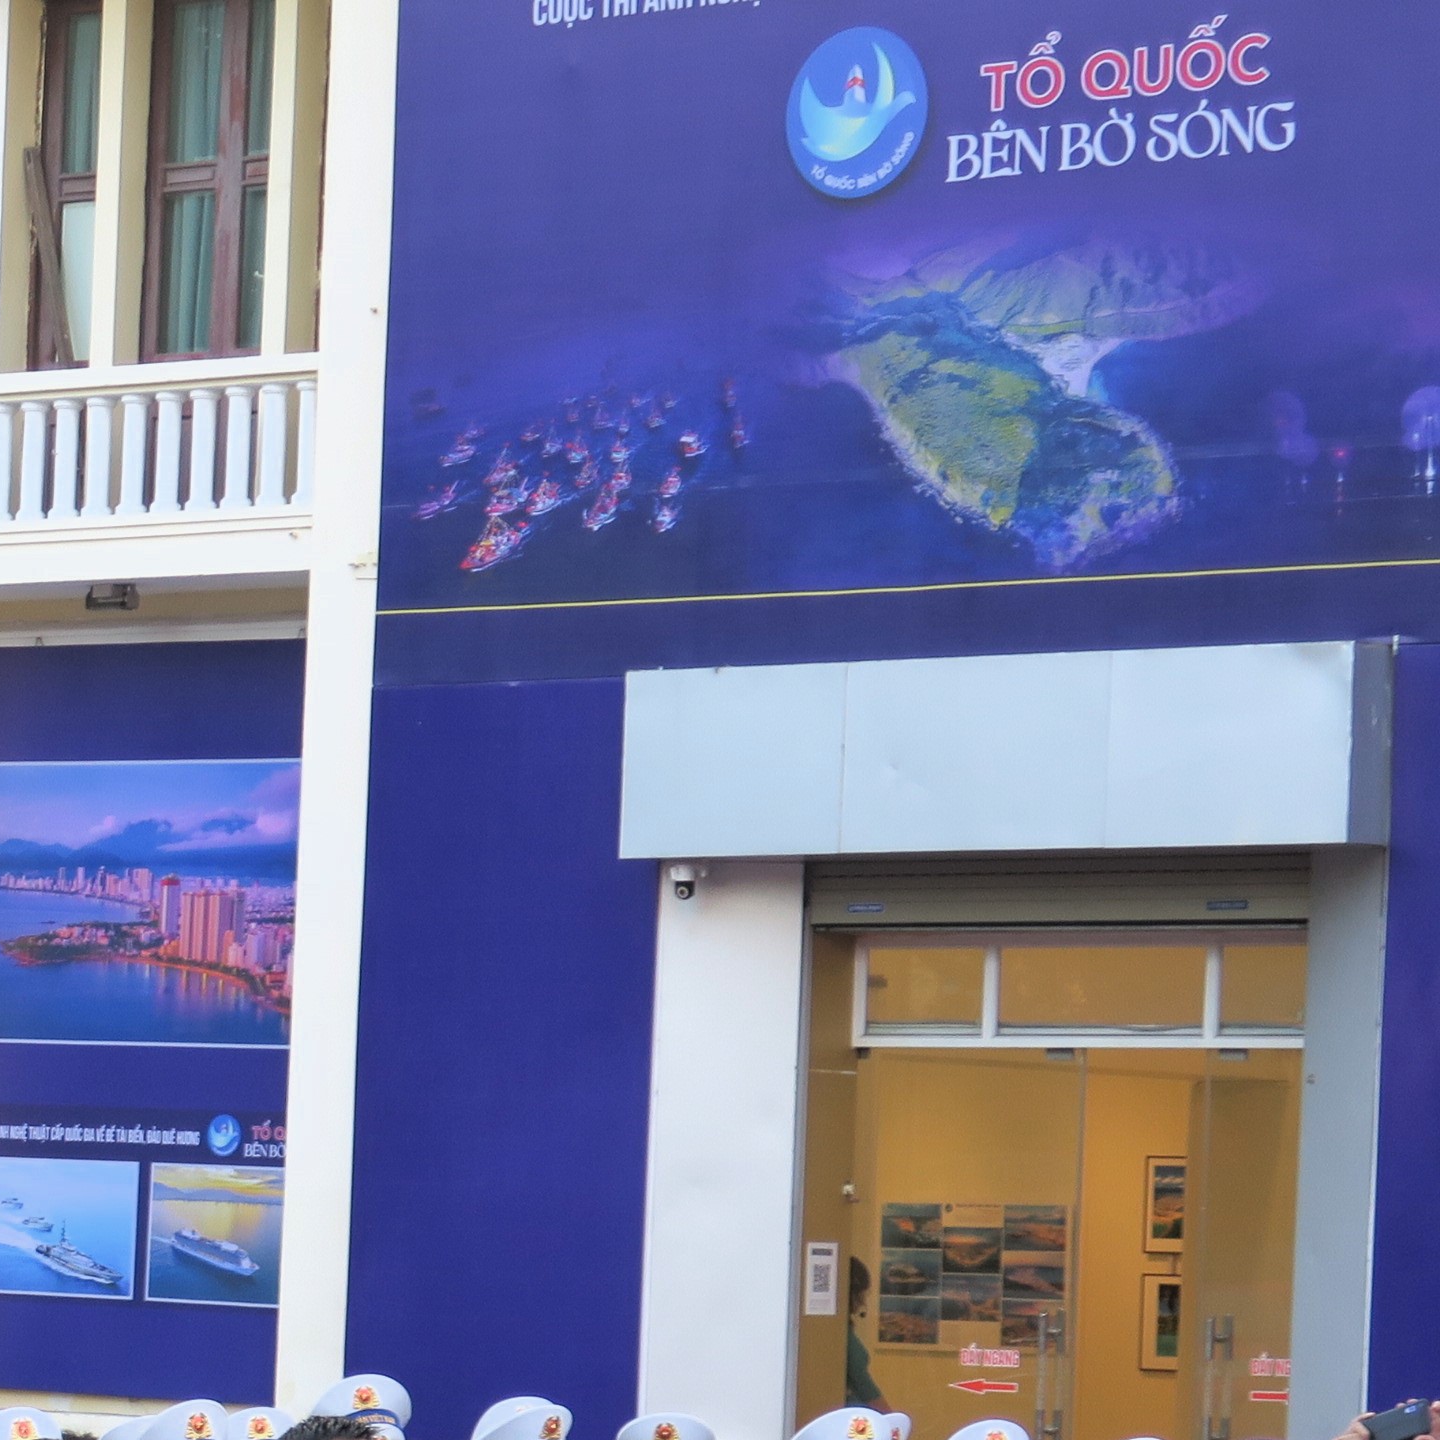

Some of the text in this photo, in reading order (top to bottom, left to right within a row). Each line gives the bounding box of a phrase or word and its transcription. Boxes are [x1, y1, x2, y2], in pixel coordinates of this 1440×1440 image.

[980, 14, 1271, 112] TỔ QUỐC
[945, 99, 1296, 182] BÊN BỜ SÓNG
